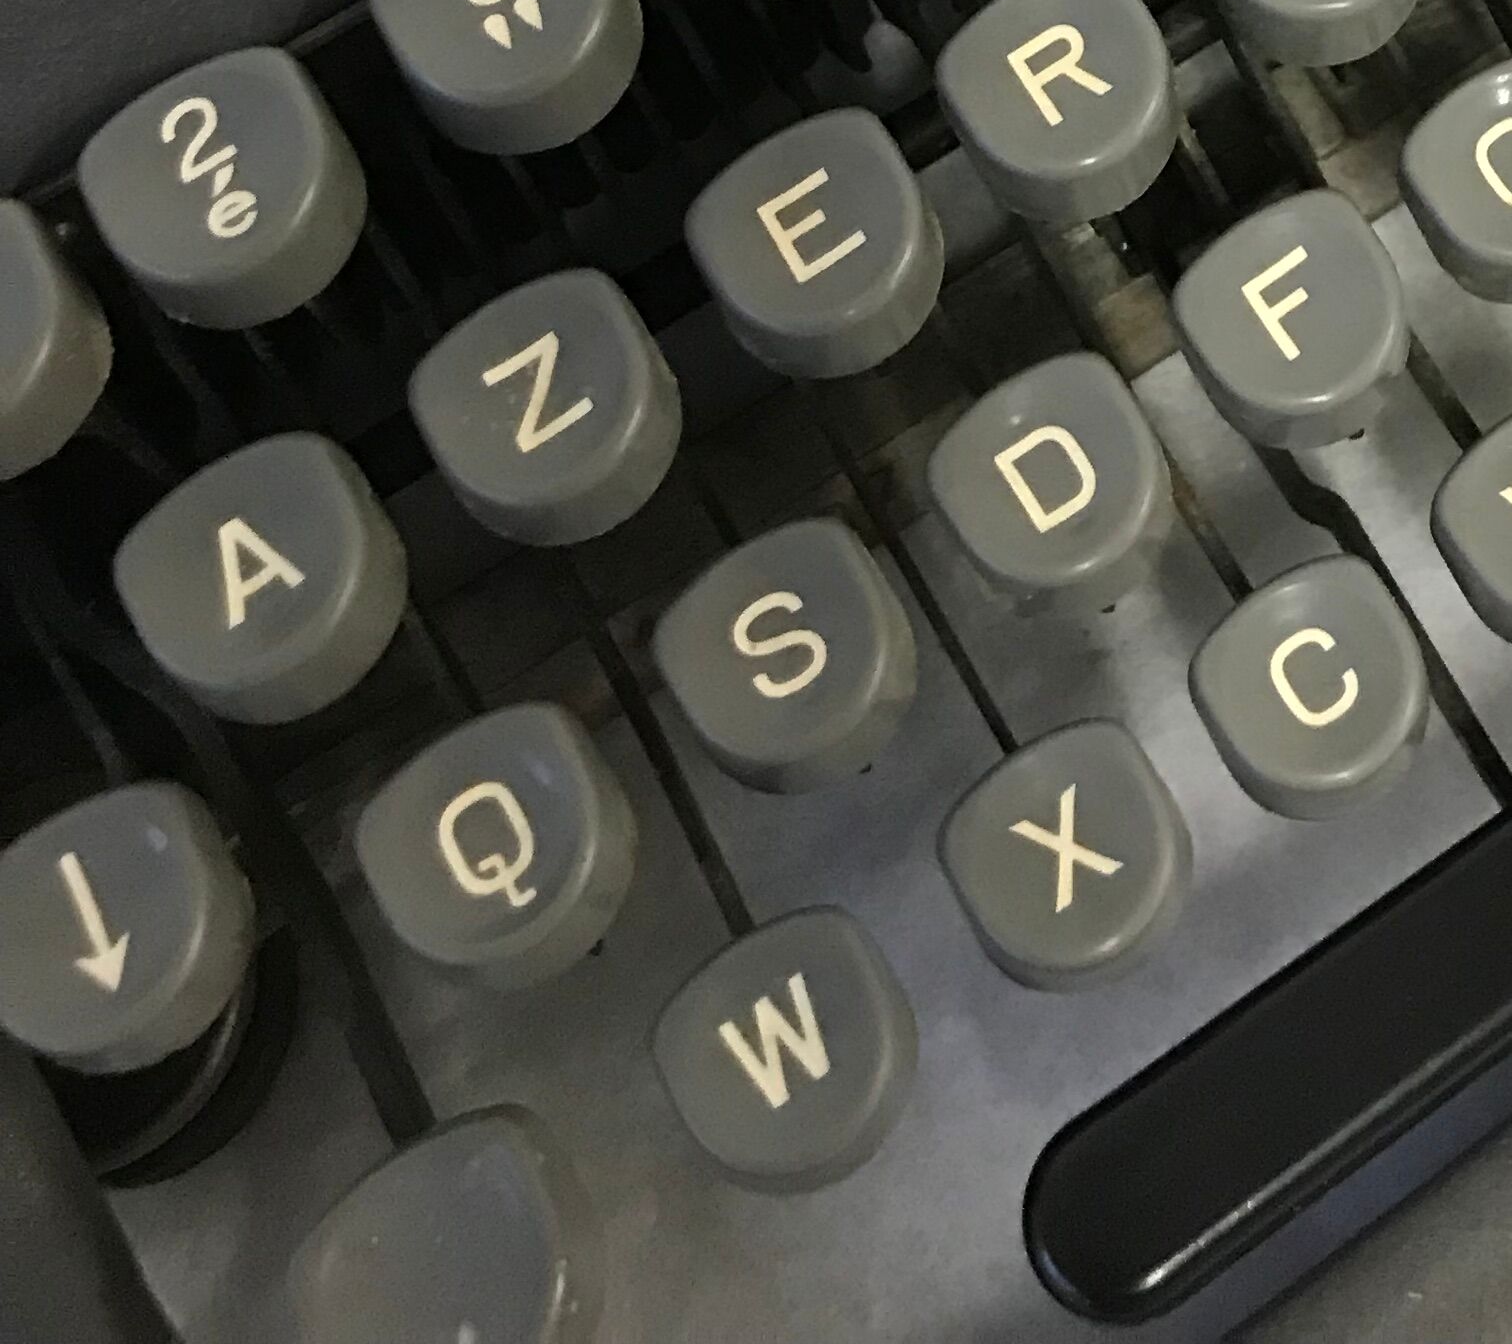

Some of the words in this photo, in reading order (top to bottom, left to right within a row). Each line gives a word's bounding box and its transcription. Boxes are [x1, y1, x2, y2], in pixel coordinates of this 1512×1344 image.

[1006, 24, 1113, 127] R
[161, 97, 239, 184] 2
[207, 162, 259, 239] é
[756, 167, 866, 283] E
[1241, 245, 1309, 361] F
[482, 331, 594, 453] Z
[994, 425, 1096, 533] D
[217, 518, 305, 630] A
[733, 591, 827, 698] S
[1270, 628, 1359, 727] C
[438, 782, 537, 907] Q
[1009, 783, 1123, 913] X
[718, 973, 830, 1109] W
